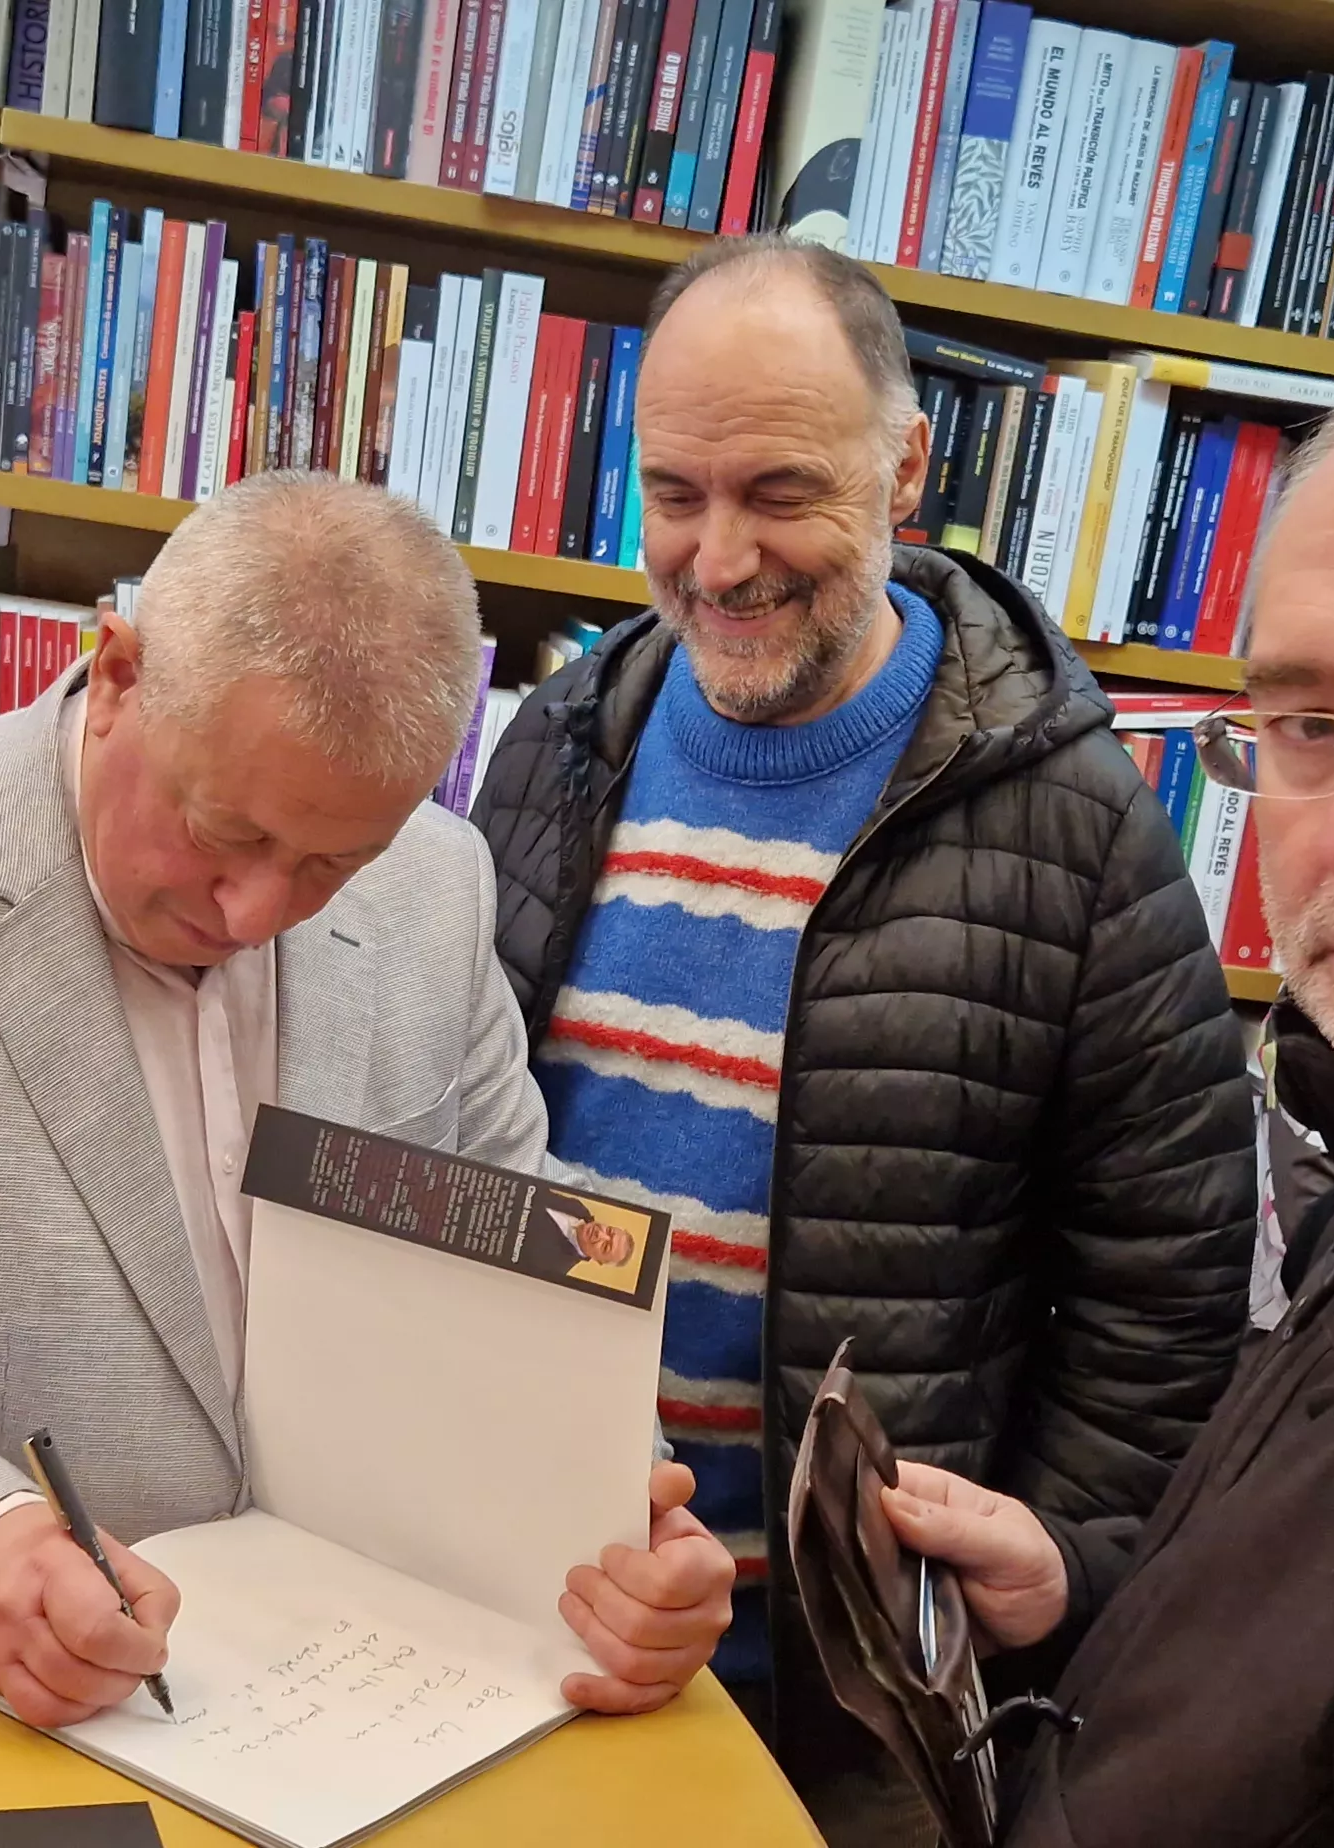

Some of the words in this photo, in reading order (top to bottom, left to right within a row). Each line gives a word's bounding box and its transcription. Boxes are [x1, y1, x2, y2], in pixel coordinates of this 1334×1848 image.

[934, 6, 949, 49] MONTERO
[928, 49, 943, 87] SÁNCHEZ
[1049, 45, 1064, 63] EL
[1099, 61, 1112, 87] MITO
[1152, 65, 1161, 75] LA
[659, 85, 676, 99] EL
[925, 88, 936, 112] MANU
[1039, 67, 1060, 119] MUNDO
[1095, 96, 1102, 104] LA
[1097, 87, 1104, 96] DE
[1144, 76, 1159, 119] INVENCIÓN
[920, 112, 933, 145] JUEGOS
[1035, 123, 1050, 140] AL
[1084, 105, 1105, 164] TRANSICIÓN
[1142, 120, 1150, 131] DE
[918, 145, 928, 163] LOS
[1137, 133, 1148, 158] JESÚS
[916, 163, 925, 175] DE
[1026, 144, 1048, 190] REVÉS
[1134, 159, 1143, 169] DE
[912, 176, 923, 200] LIBRO
[1076, 165, 1094, 210] PACÍFICA
[1152, 159, 1175, 216] CHURCHILL
[908, 201, 919, 224] GRAN
[1022, 200, 1039, 234] YANG
[906, 226, 915, 235] EL
[1059, 214, 1075, 253] BABY
[1141, 215, 1164, 263] WINSTON
[517, 290, 534, 331] Pablo
[477, 302, 496, 358] SICALÍPTICAS
[42, 321, 58, 374] ARAGÓN
[509, 334, 527, 384] Picasso
[96, 368, 108, 398] COSTA
[470, 360, 489, 415] BATURRADAS
[1118, 376, 1130, 399] ¿QUÉ
[92, 399, 105, 445] JOAQUÍN
[473, 417, 481, 429] de
[1113, 417, 1122, 428] EL
[1115, 400, 1125, 416] FUE
[464, 430, 482, 478] ANTOLOGÍA
[1102, 429, 1120, 491] FRANQUISMO?
[1024, 527, 1056, 600] AZORÍN
[1221, 817, 1235, 833] AL
[1213, 836, 1232, 877] REVÉS
